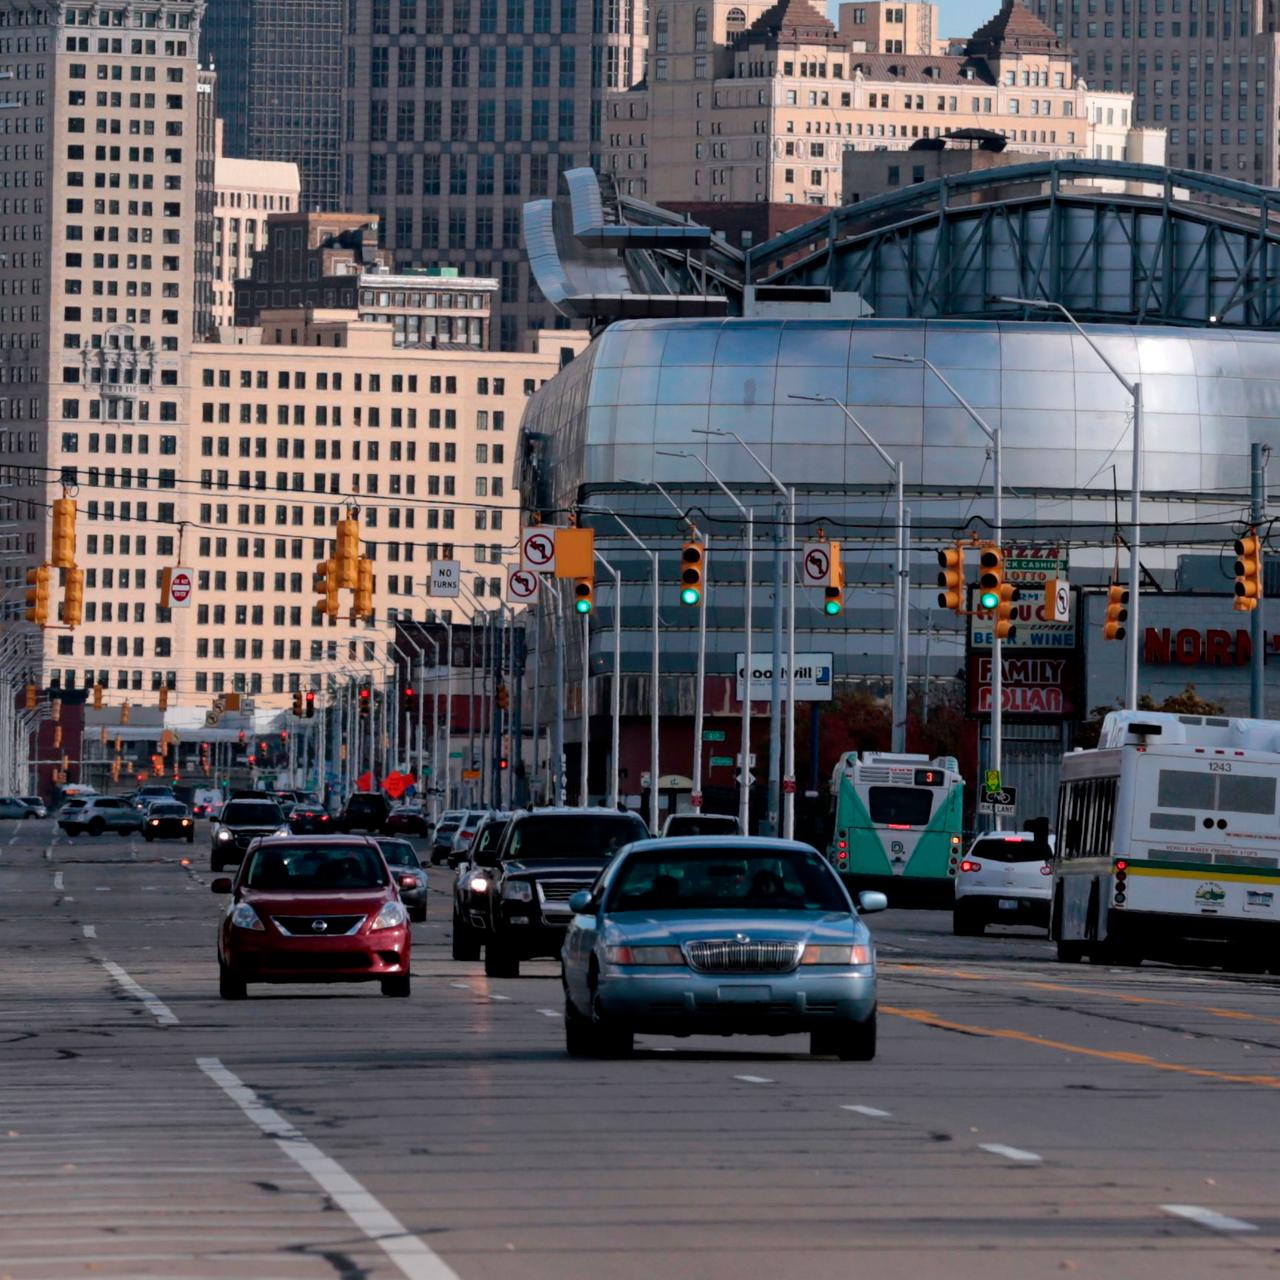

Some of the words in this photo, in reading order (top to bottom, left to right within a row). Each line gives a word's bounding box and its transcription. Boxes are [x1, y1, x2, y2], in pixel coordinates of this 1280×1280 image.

[1031, 634, 1073, 646] WINE
[980, 658, 1066, 683] FAMILY
[1208, 762, 1232, 772] 1243
[926, 772, 933, 783] 3
